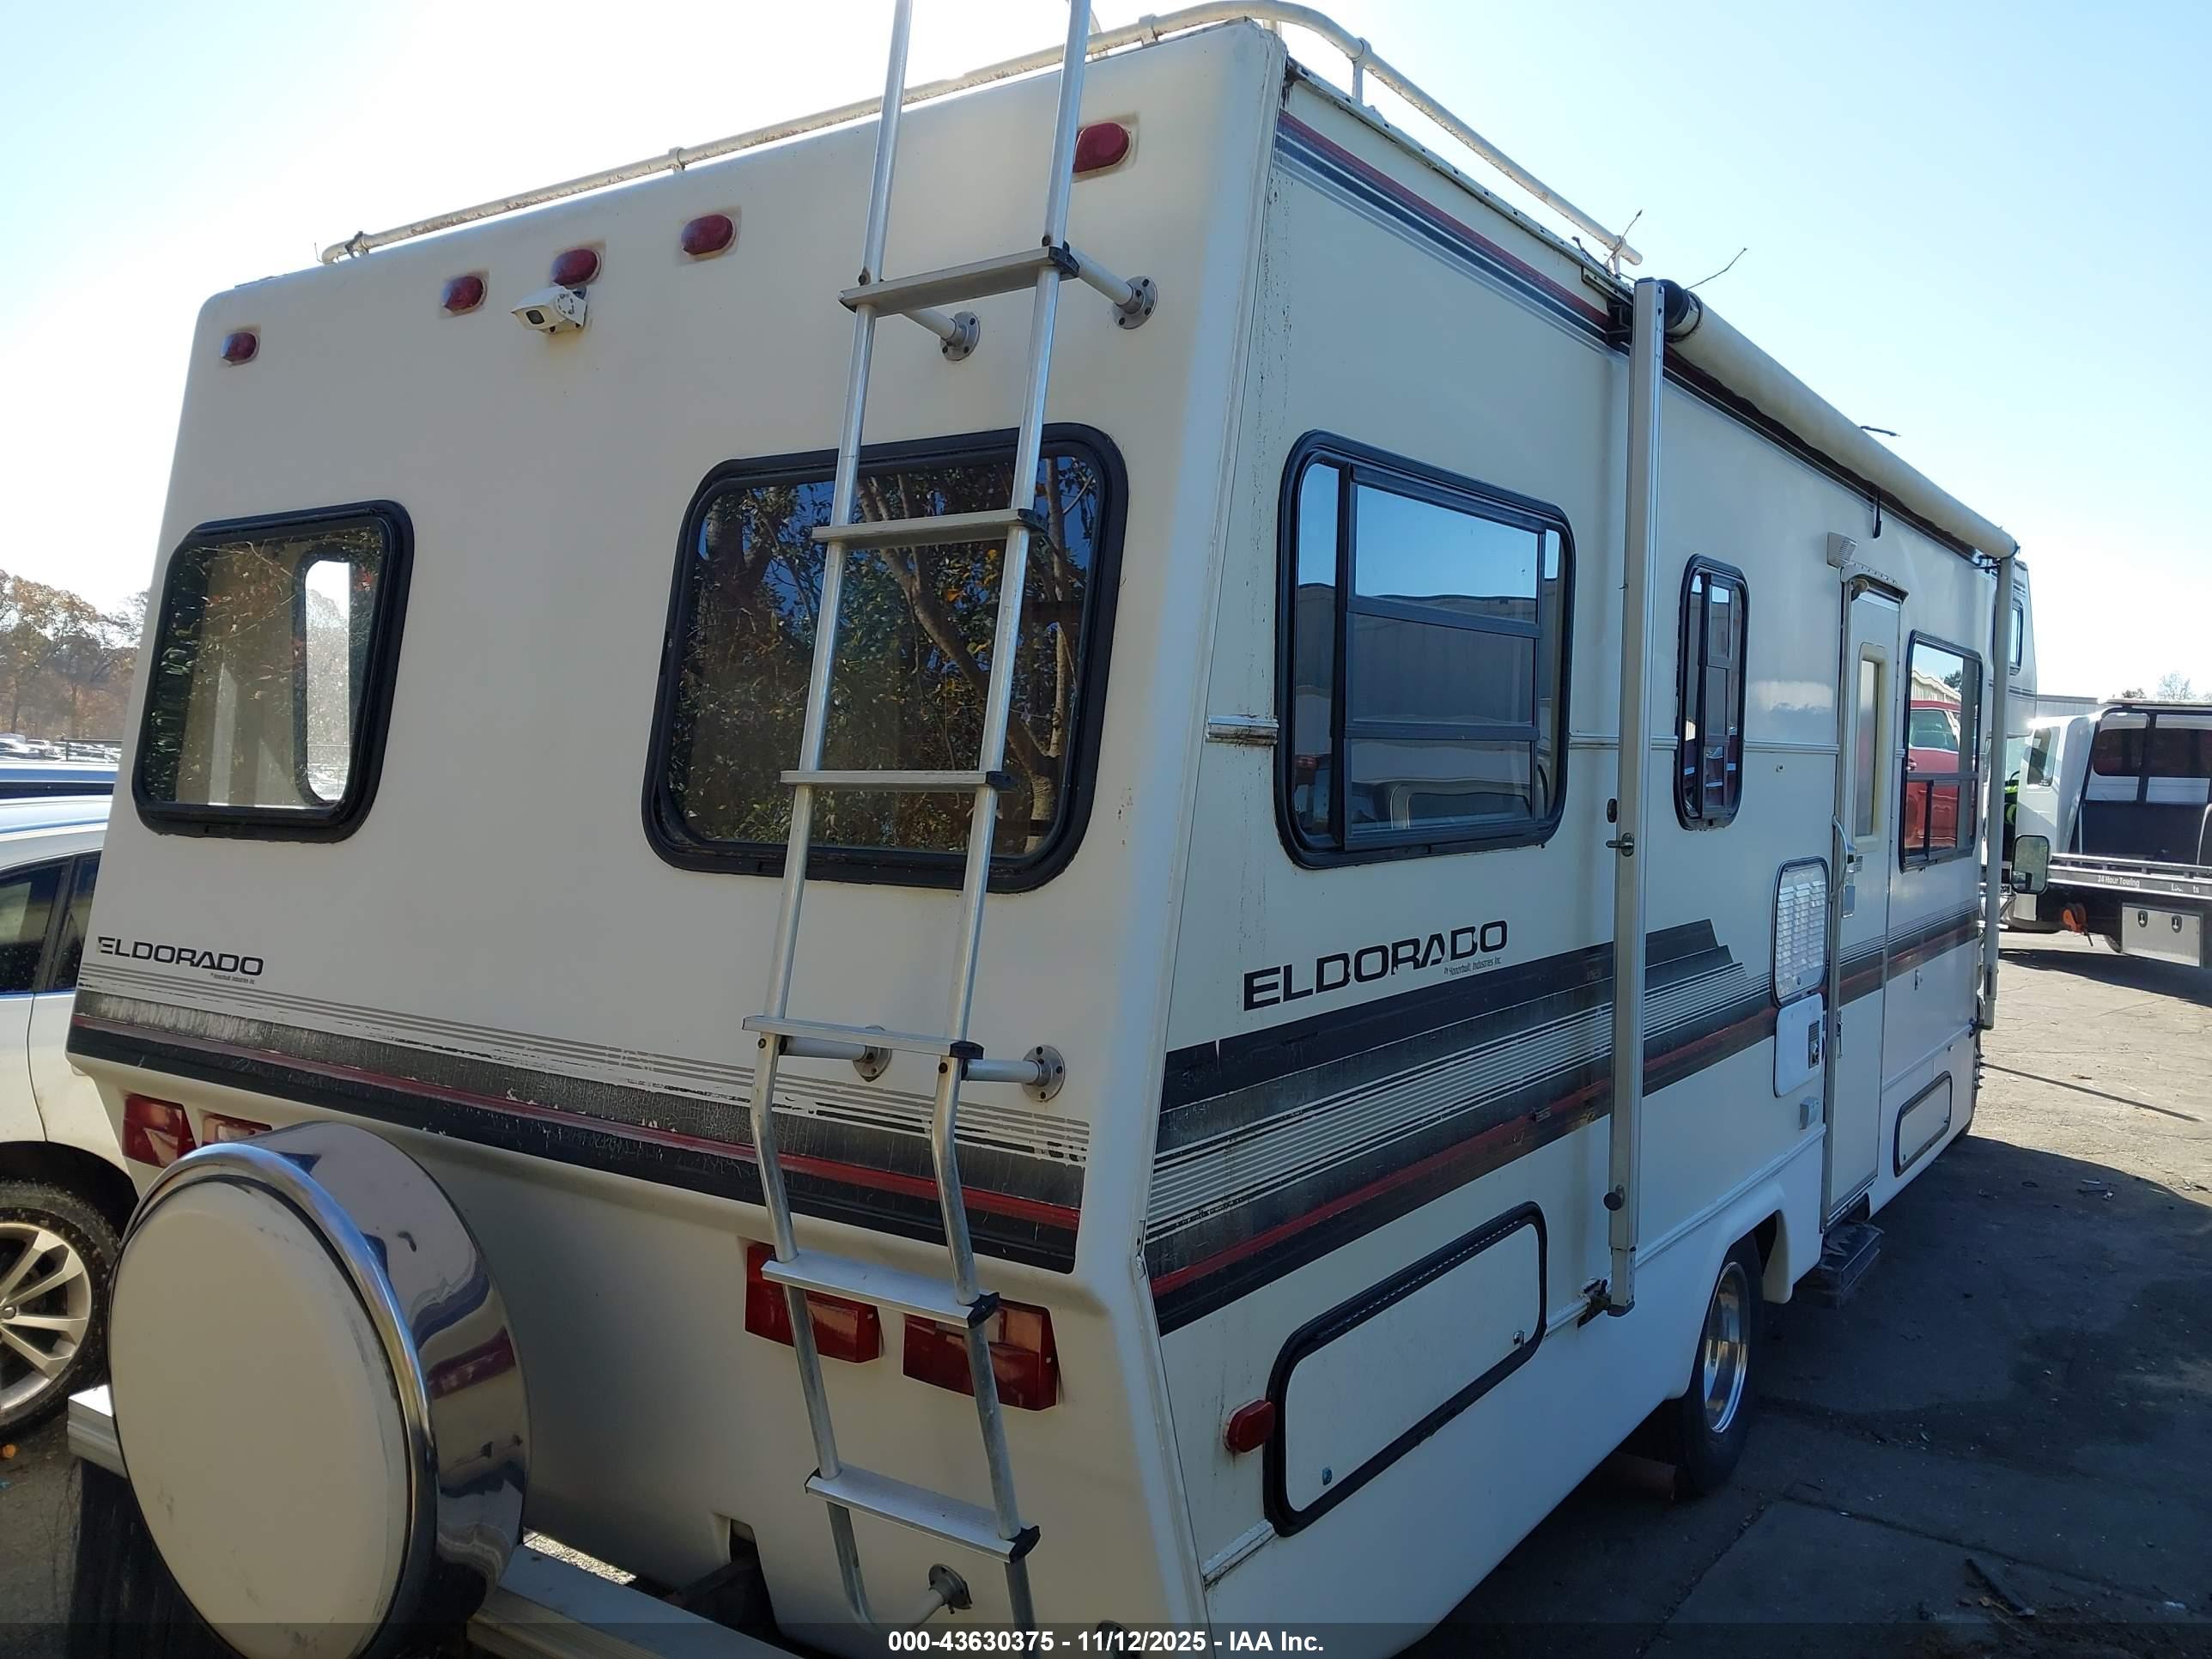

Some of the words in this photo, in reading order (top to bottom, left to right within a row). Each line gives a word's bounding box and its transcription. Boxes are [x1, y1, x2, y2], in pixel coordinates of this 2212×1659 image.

[2106, 876, 2118, 885] Hour
[2119, 877, 2140, 889] Towing
[97, 936, 264, 976] ELDORADO
[1243, 920, 1508, 1012] ELDORADO
